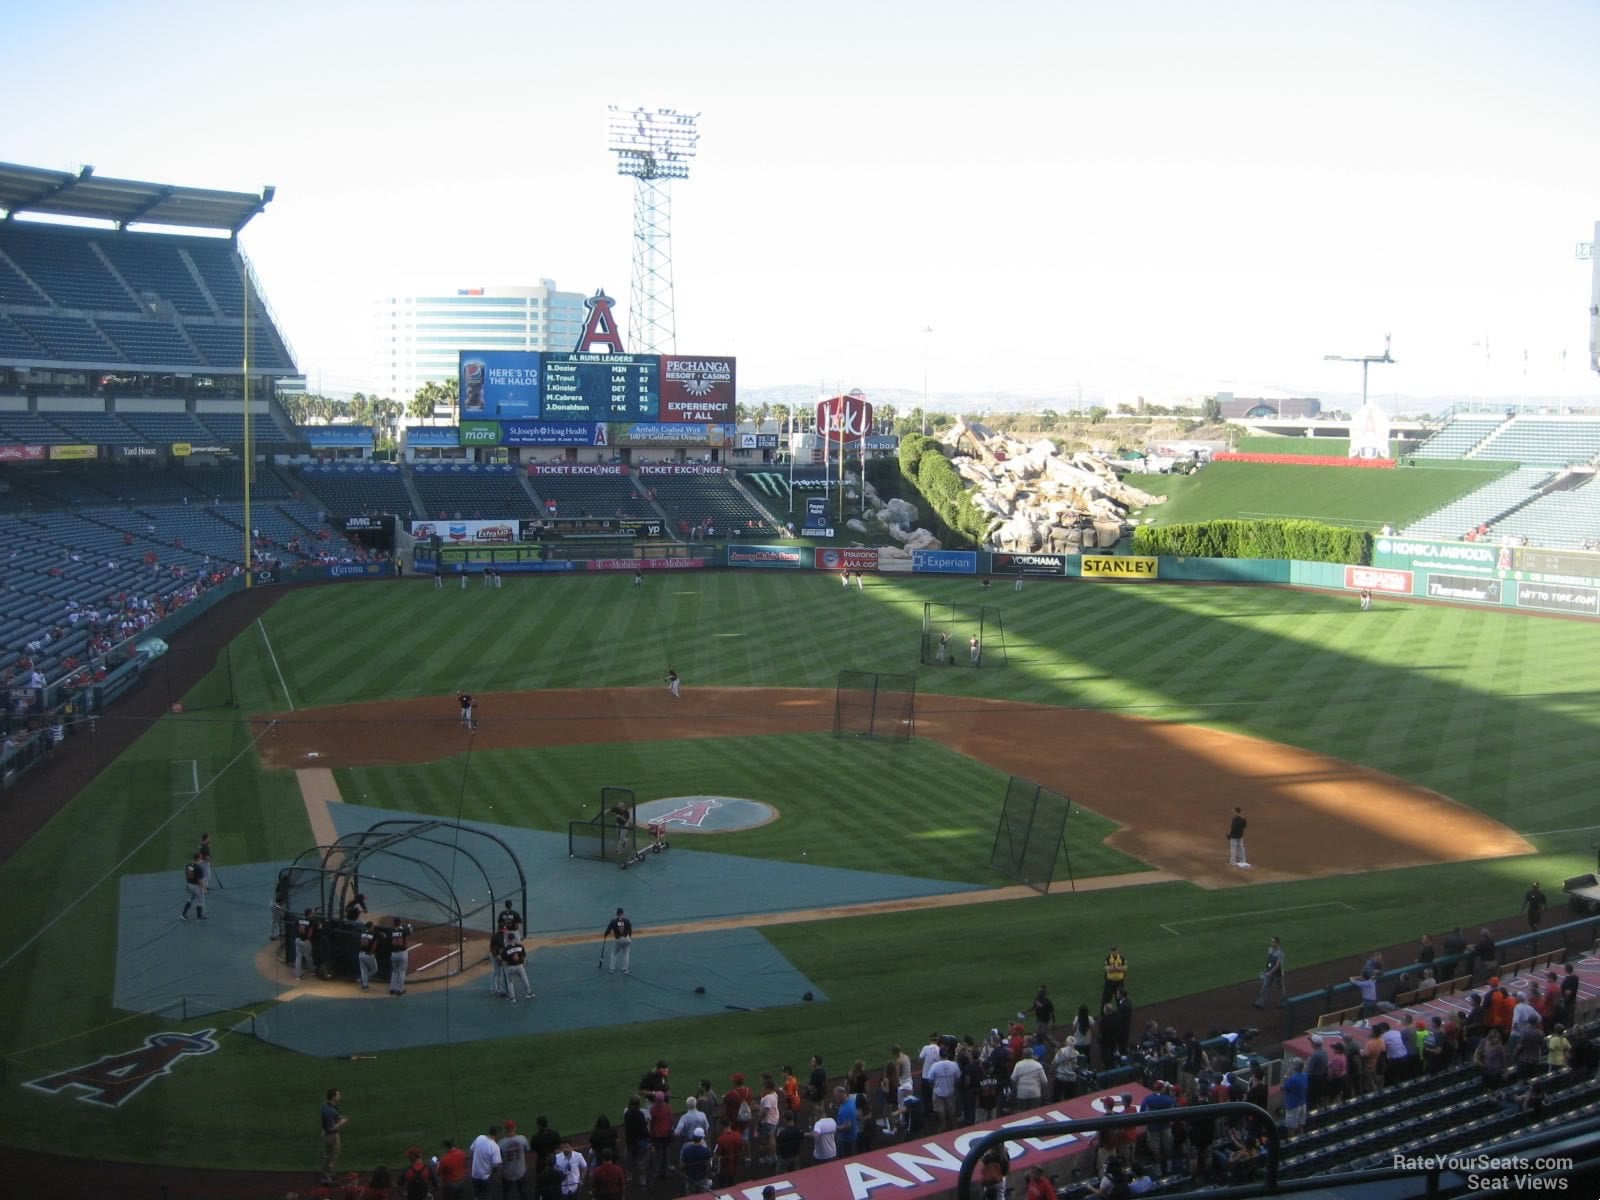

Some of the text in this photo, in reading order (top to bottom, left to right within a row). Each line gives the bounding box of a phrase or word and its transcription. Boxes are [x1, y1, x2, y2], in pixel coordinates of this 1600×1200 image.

[601, 355, 634, 363] LEADERS
[546, 364, 578, 372] B.Dozier
[667, 360, 730, 372] PECHANGA
[488, 368, 538, 378] HERE'S TO
[546, 374, 576, 382] M.Trout
[666, 372, 695, 380] RESORT
[490, 377, 506, 386] THE
[508, 378, 538, 387] HALOS
[546, 384, 577, 392] I.Kinsler
[546, 394, 583, 402] M.Cabrera
[546, 403, 590, 412] J.Donaldson
[683, 411, 713, 421] IT ALL
[565, 427, 588, 435] Health
[635, 426, 658, 434] Artfully
[465, 430, 496, 441] more
[649, 433, 682, 441] California
[682, 434, 708, 443] Oranges
[879, 442, 896, 450] box
[123, 447, 157, 456] Yard House
[535, 465, 622, 475] TICKET EXCHANGE
[640, 465, 723, 475] TICKET EXCHANGE
[647, 525, 661, 535] yp
[1392, 542, 1494, 562] KONICA MINOLTA
[927, 556, 969, 569] Experian
[1011, 556, 1061, 566] YOKOHAMA
[1083, 558, 1156, 574] STANLEY
[331, 564, 363, 577] Corona
[1430, 582, 1488, 600] Thermador
[1519, 588, 1549, 601] NITTO
